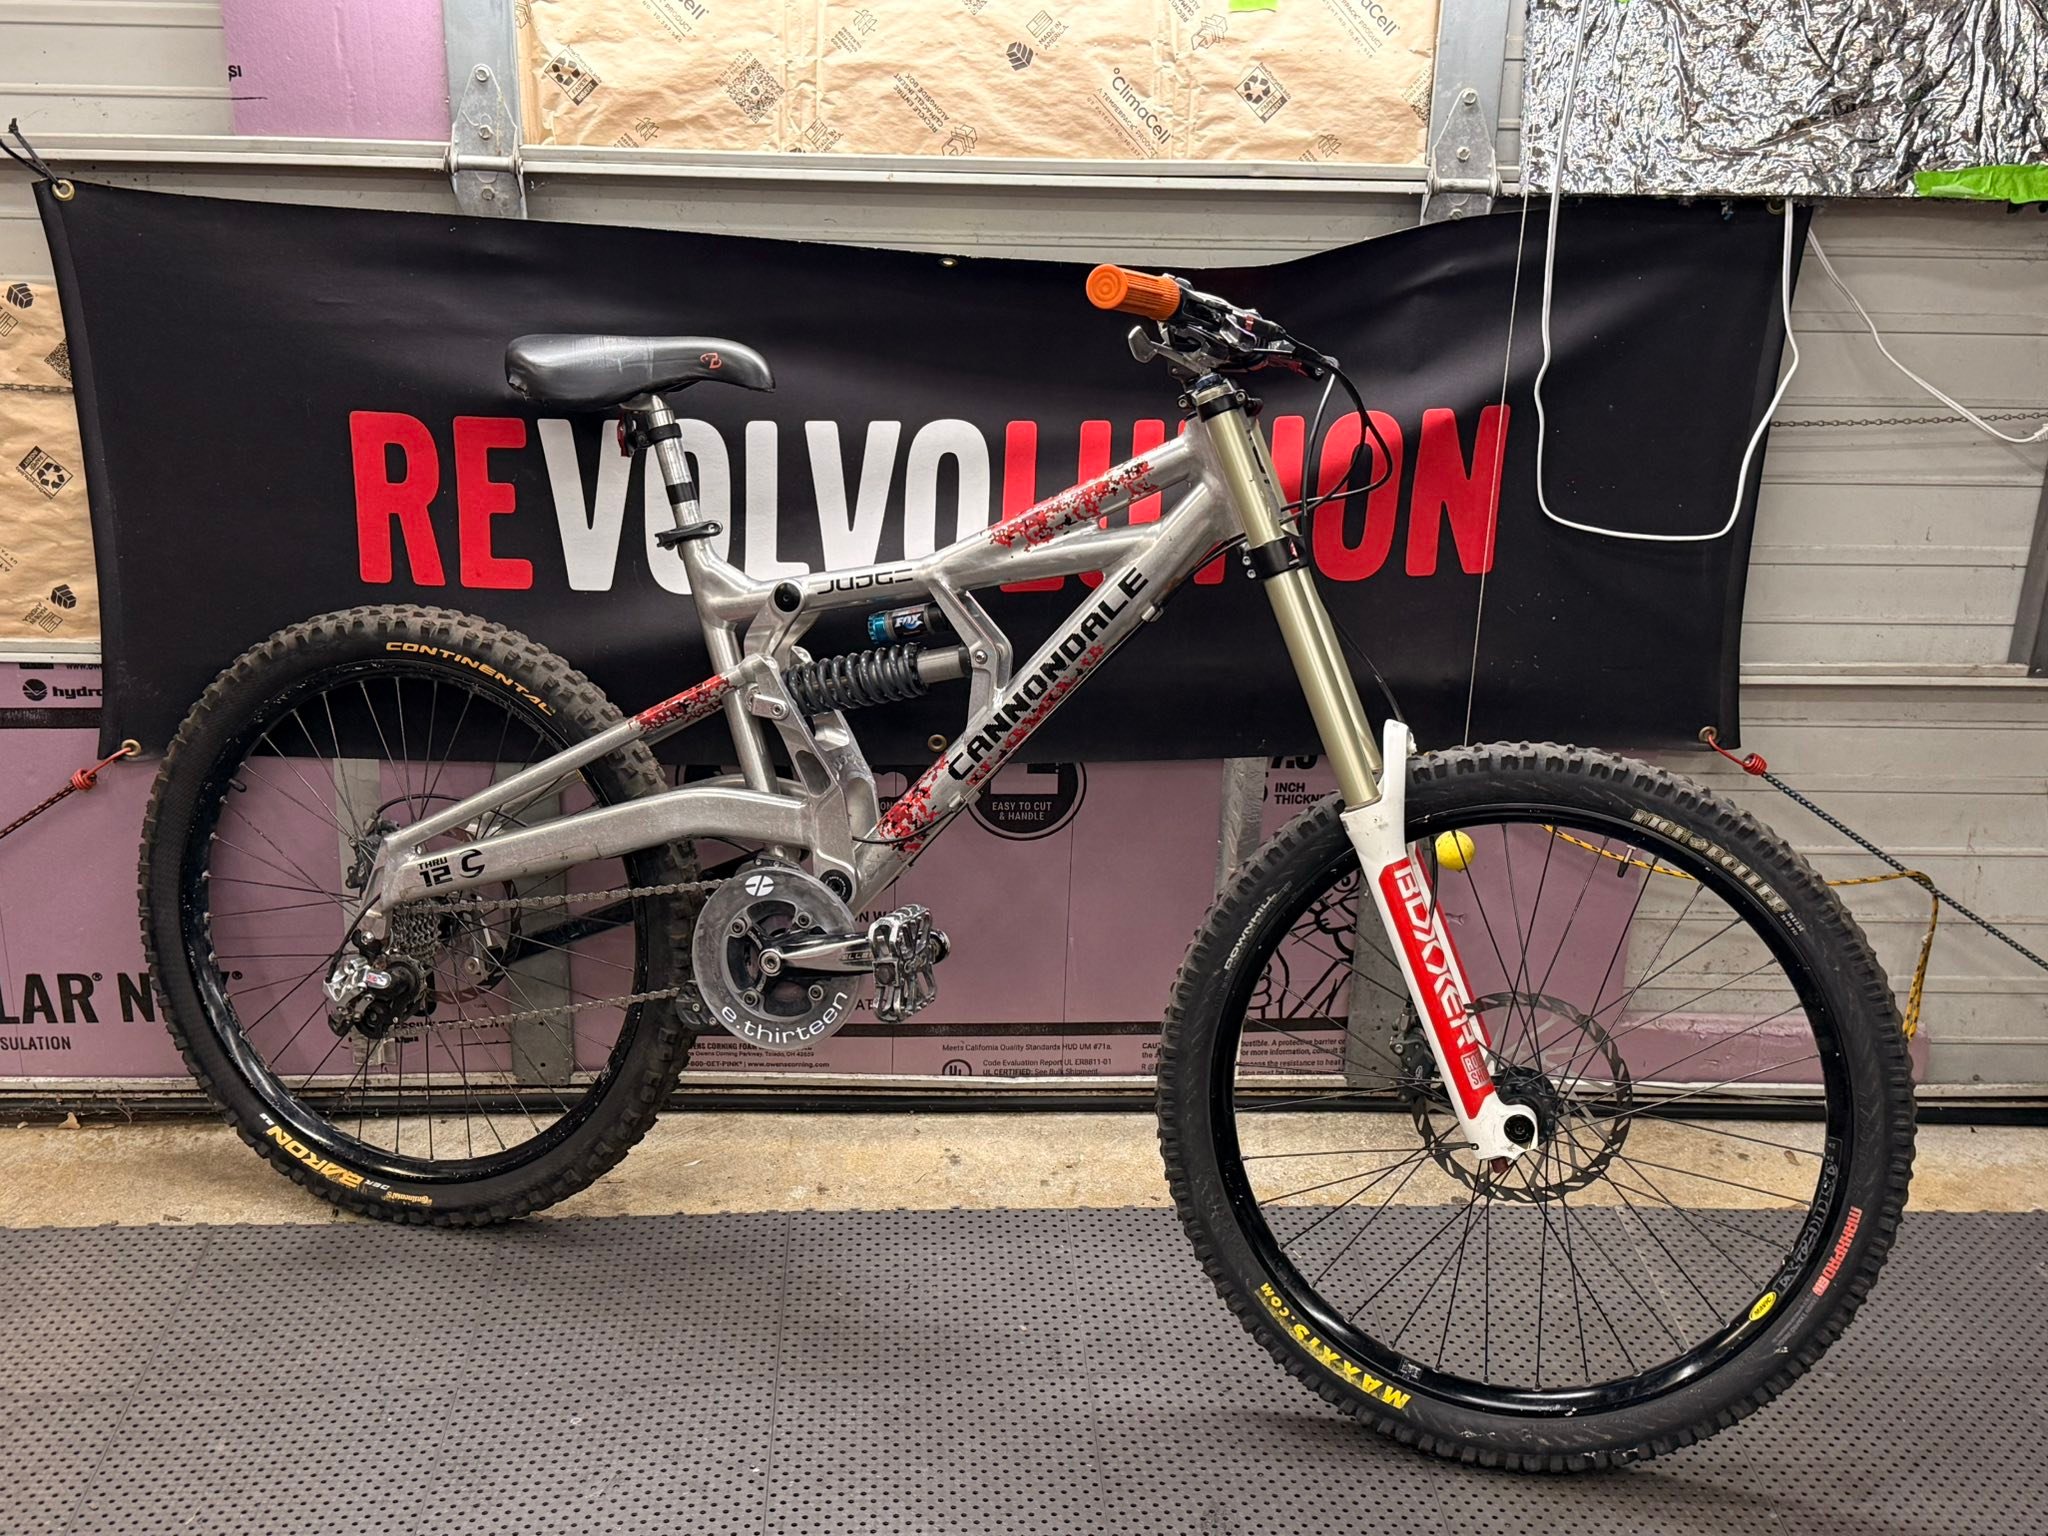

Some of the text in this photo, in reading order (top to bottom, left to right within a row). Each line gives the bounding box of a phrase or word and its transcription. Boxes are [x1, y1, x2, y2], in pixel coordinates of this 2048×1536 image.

[1037, 26, 1056, 46] MADE
[892, 71, 944, 128] CLIMACELL INSERT
[903, 72, 950, 122] ALONGSIDE BOX
[892, 83, 938, 134] RECYCLE ENTIRE
[894, 612, 924, 631] FOX
[386, 641, 556, 717] CONTINENTAL
[948, 567, 1149, 781] CANNONDALE
[1275, 782, 1305, 793] INCH
[992, 802, 1052, 811] EASY TO CUT
[999, 812, 1045, 821] & HANDLE
[417, 856, 448, 870] THRU
[419, 865, 453, 888] 12
[1224, 893, 1279, 970] DOWNHILL
[721, 991, 848, 1044] e.thirteen
[707, 1042, 738, 1050] CORNING
[965, 1043, 998, 1051] California
[1000, 1043, 1024, 1052] Quality
[1025, 1043, 1060, 1051] Standards
[1270, 1047, 1312, 1056] information,
[1314, 1038, 1337, 1046] barrier
[1040, 1059, 1062, 1068] Report
[1267, 1059, 1279, 1067] the
[1280, 1059, 1316, 1067] resistance
[1325, 1058, 1341, 1066] heat
[266, 1125, 366, 1189] BARON
[364, 1178, 391, 1192] DER
[1753, 1296, 1772, 1316] MAVIC
[1259, 1282, 1412, 1410] MAXXIS.COM
